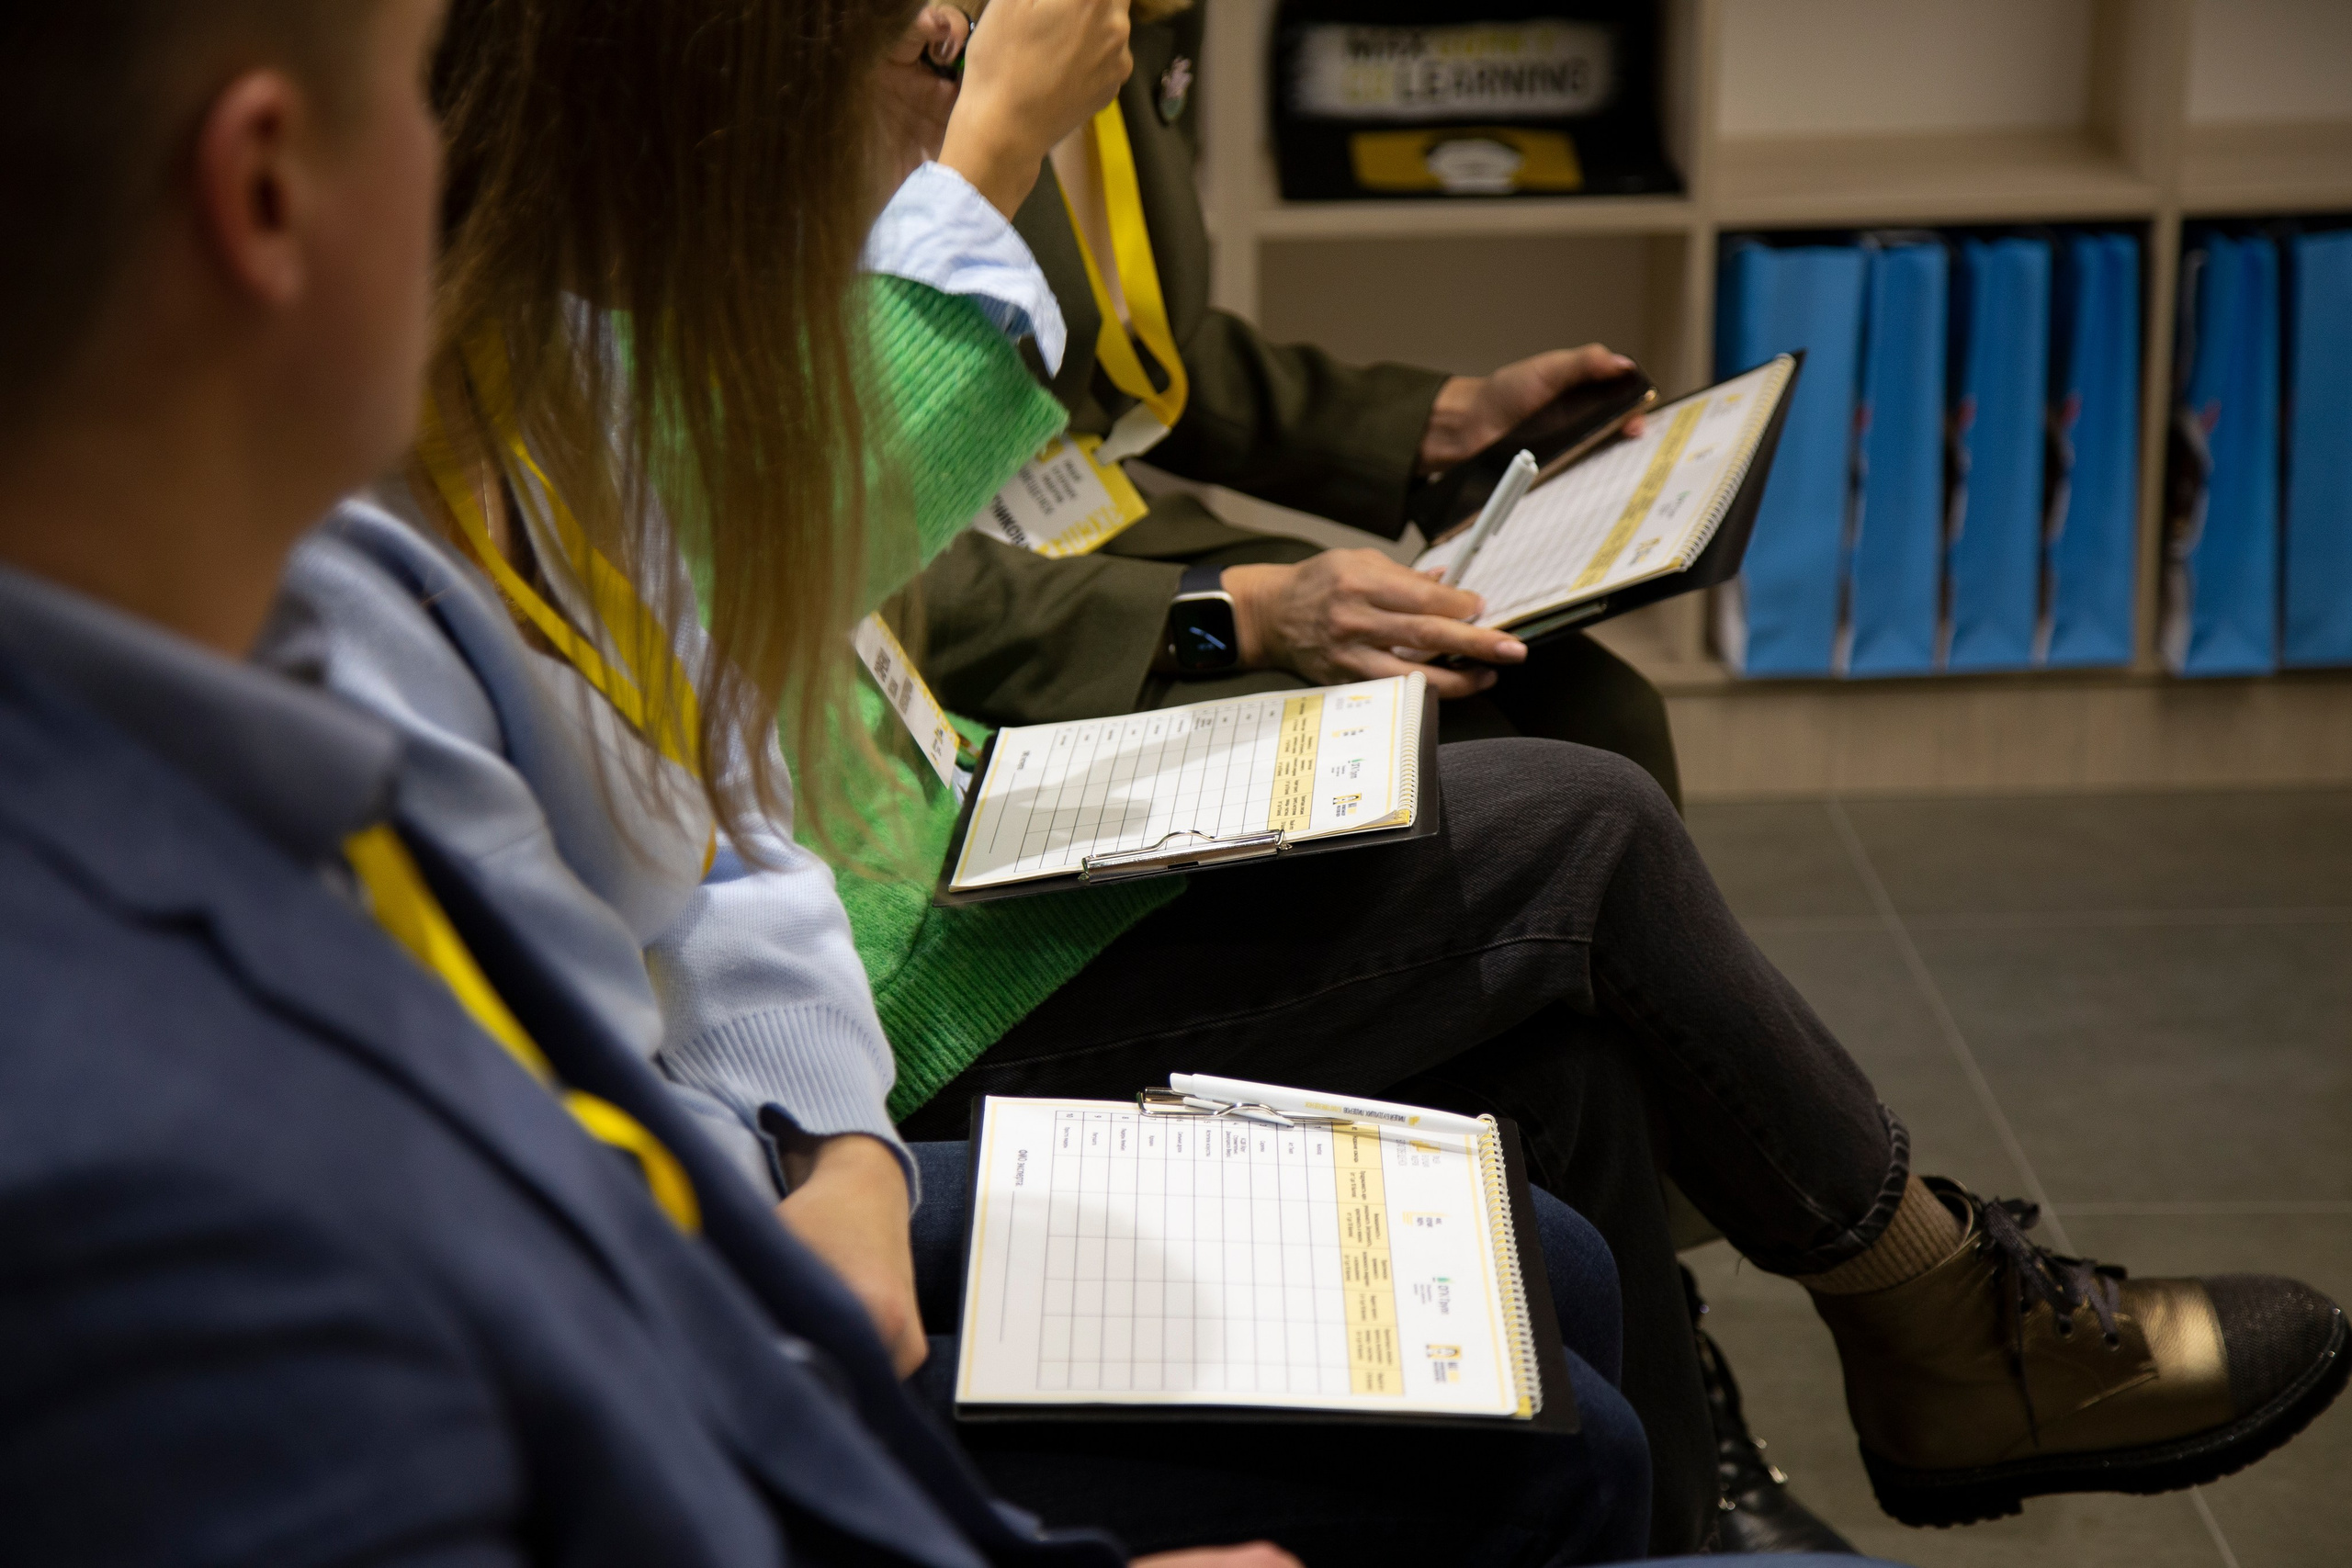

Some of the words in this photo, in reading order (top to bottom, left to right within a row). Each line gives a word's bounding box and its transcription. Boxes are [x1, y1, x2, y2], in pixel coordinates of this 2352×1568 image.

[1343, 1107, 1364, 1115] ЛИДЕРОВ
[1364, 1110, 1389, 1120] БУДУЩИХ
[1388, 1113, 1406, 1122] ЛИЦЕЙ
[1017, 1149, 1027, 1161] ФИО
